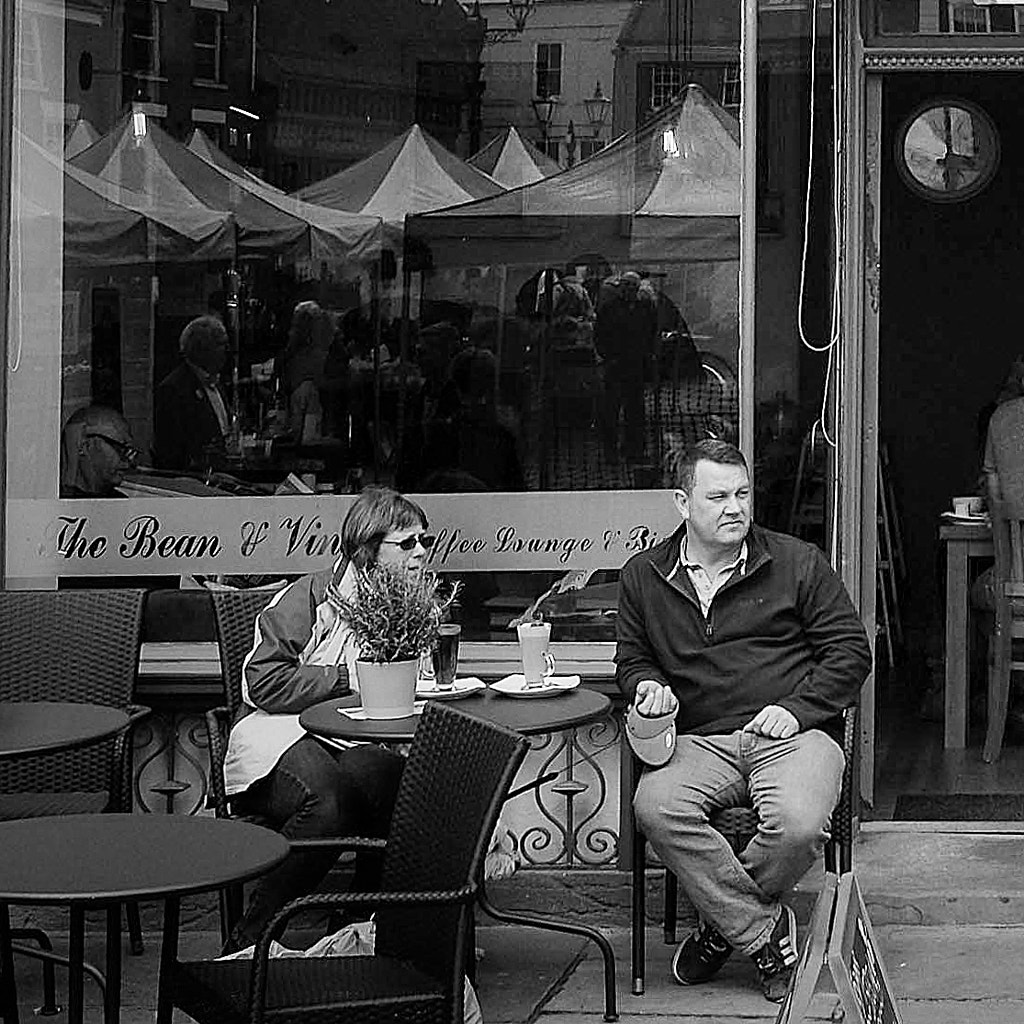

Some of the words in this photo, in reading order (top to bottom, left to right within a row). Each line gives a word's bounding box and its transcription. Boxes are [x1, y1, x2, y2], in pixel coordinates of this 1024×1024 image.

[57, 516, 107, 560] The
[119, 515, 226, 560] Bean
[240, 521, 270, 557] &
[279, 514, 344, 558] Vin
[425, 528, 488, 565] ffee
[494, 526, 593, 564] Lounge
